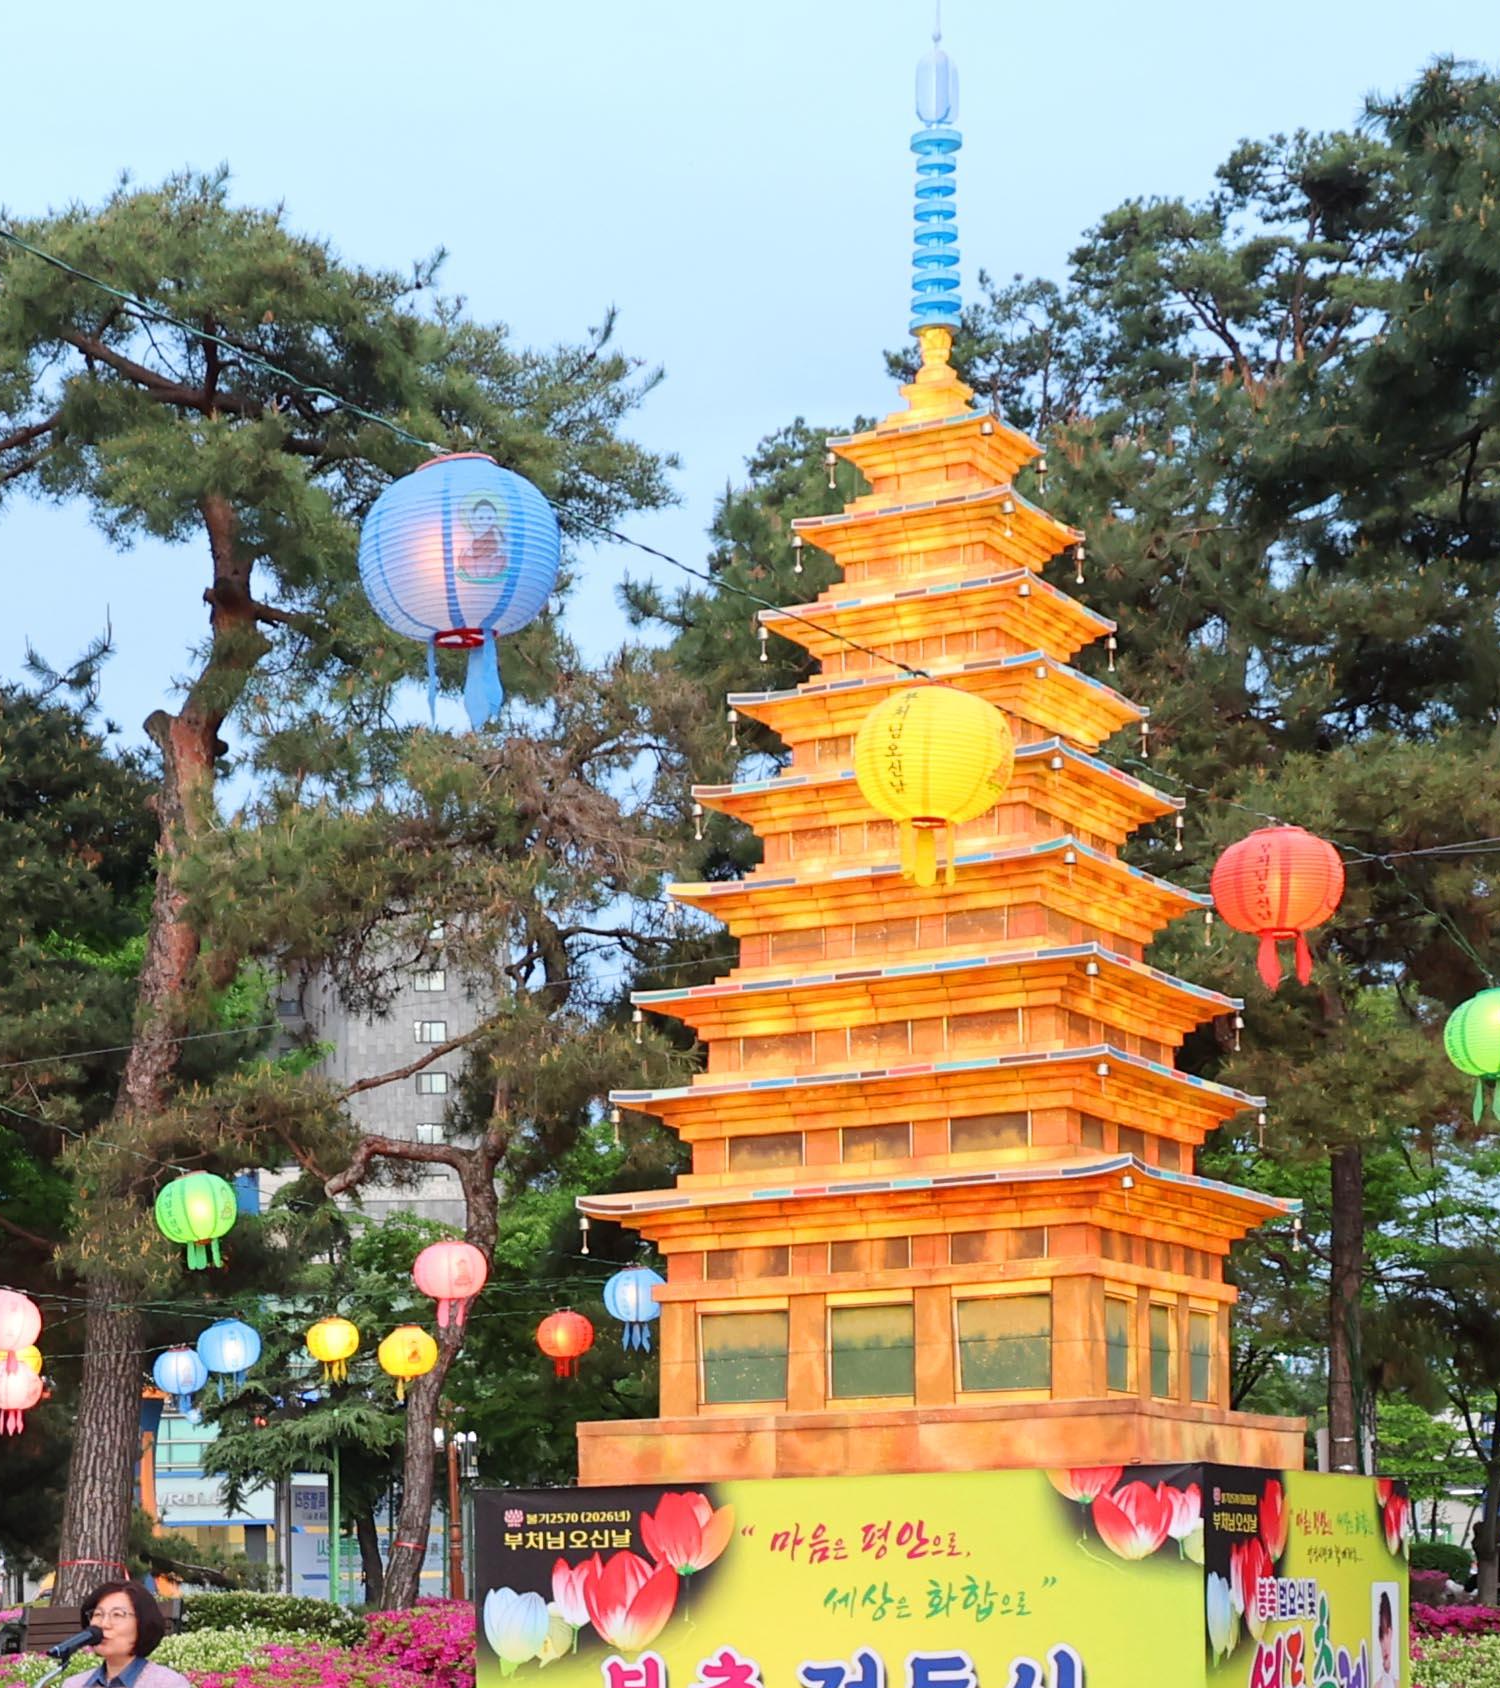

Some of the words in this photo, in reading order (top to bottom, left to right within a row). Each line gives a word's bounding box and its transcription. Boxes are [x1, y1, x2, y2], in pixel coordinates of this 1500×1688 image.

[580, 1509, 631, 1524] (2026년)
[503, 1531, 565, 1552] 부처님
[569, 1529, 633, 1551] 오신날
[823, 1582, 913, 1621] 세상은
